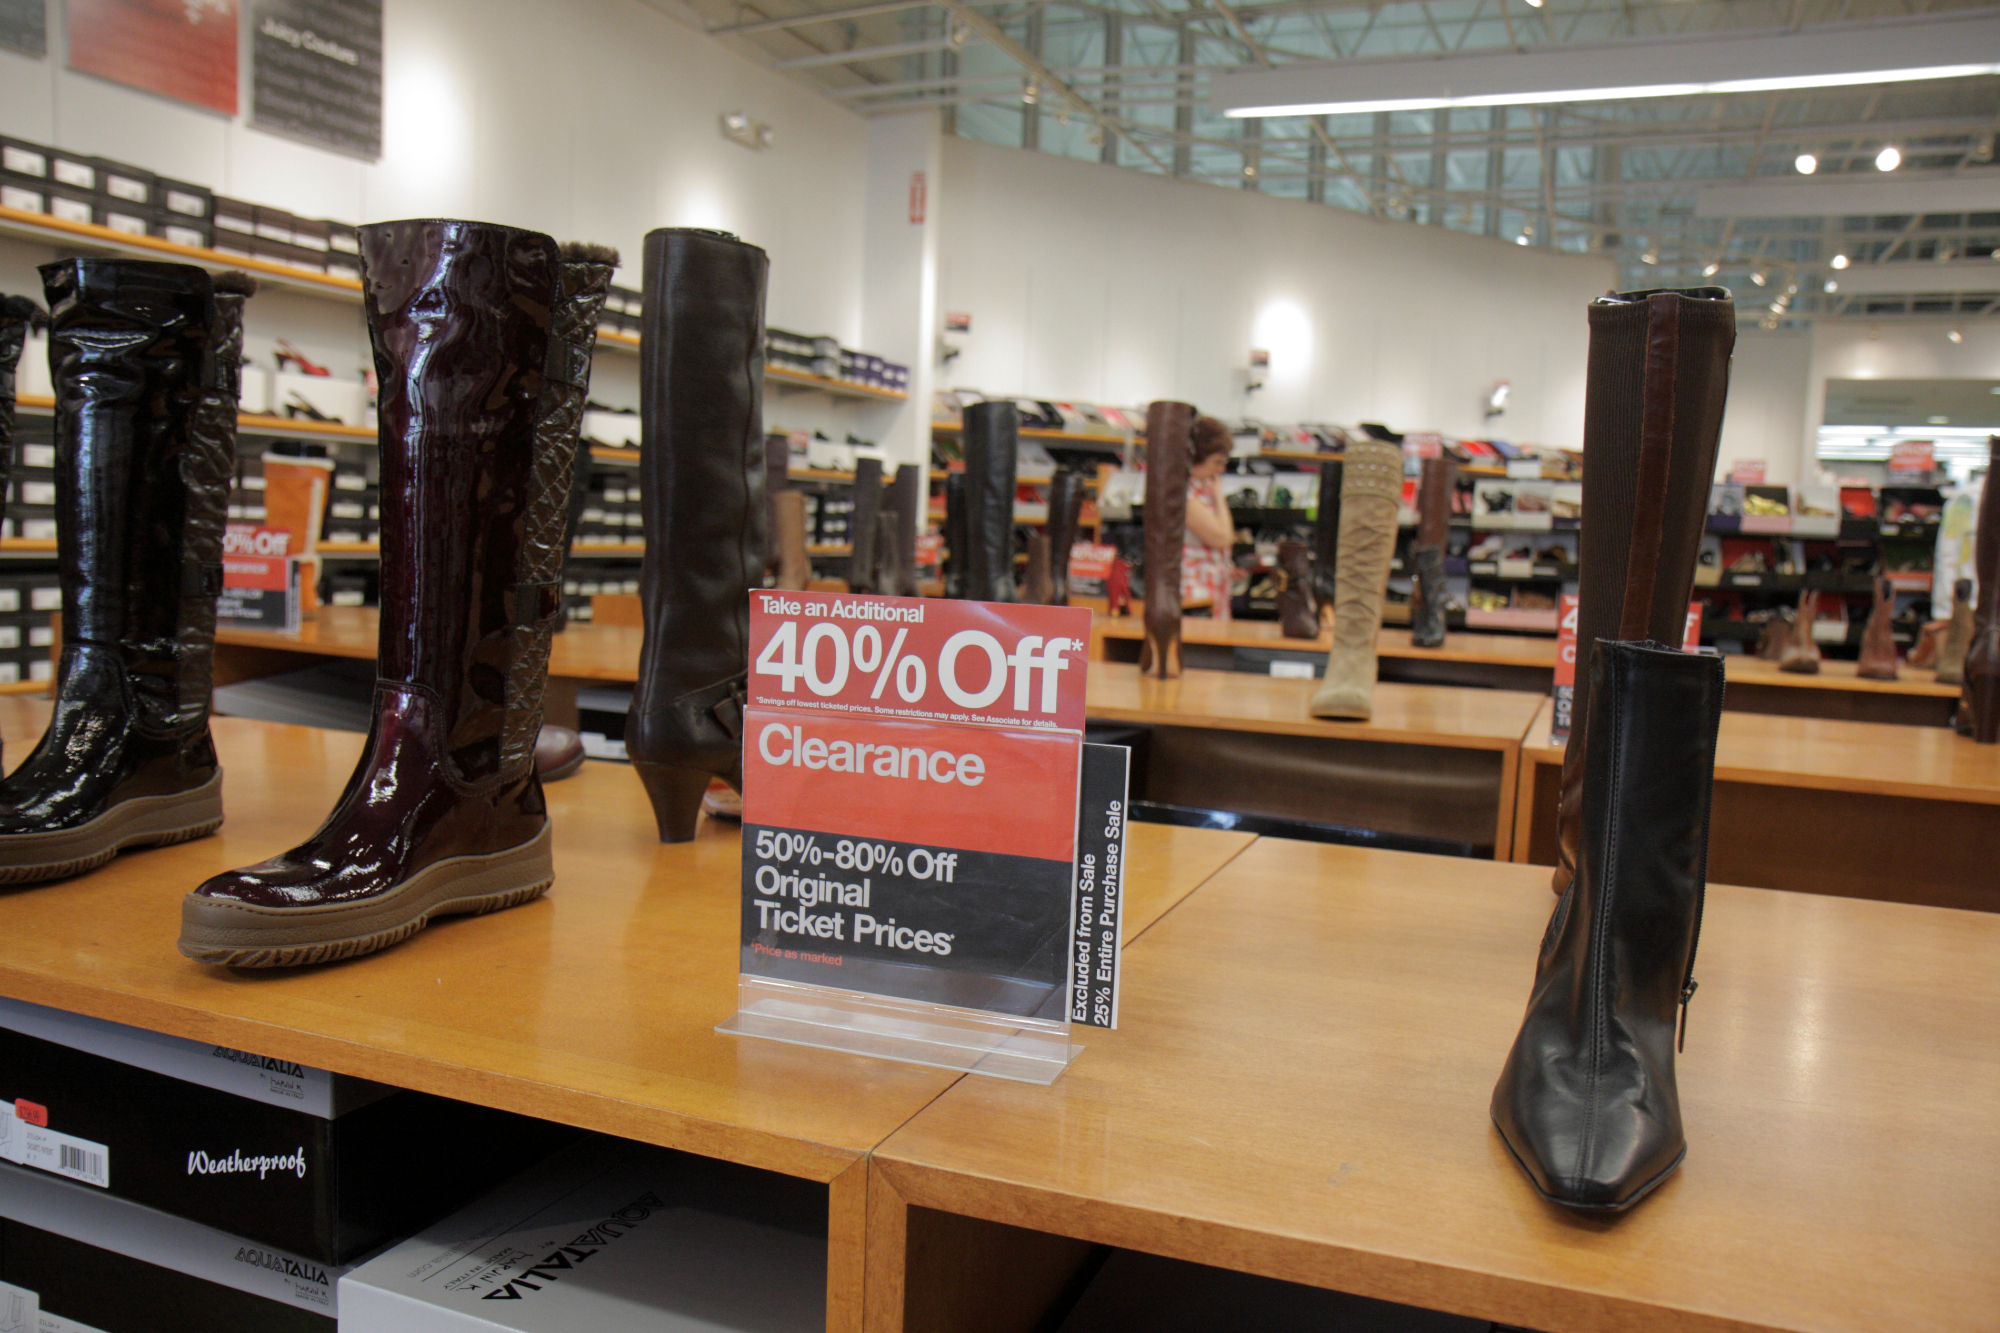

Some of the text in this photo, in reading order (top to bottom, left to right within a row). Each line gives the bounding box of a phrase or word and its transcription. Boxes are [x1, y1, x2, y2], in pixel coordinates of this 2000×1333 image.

[759, 595, 925, 623] Take an Additional
[756, 621, 927, 703] 40%
[786, 699, 797, 707] off
[797, 700, 820, 709] lowest
[820, 702, 849, 711] ticketed
[849, 704, 873, 714] prices.
[874, 706, 894, 715] Some
[895, 708, 933, 718] restrictions
[950, 714, 970, 722] apply.
[971, 714, 985, 722] See
[986, 715, 1020, 725] Associate
[1021, 717, 1032, 726] for
[1033, 718, 1058, 728] details.
[758, 722, 986, 787] Clearance
[755, 829, 958, 883] 50%-80% Off
[755, 864, 871, 908] Original
[753, 899, 845, 941] Ticket
[1093, 800, 1122, 1027] 25% Entire Purchase Sale
[784, 949, 798, 960] as
[800, 952, 843, 966] marked
[1072, 853, 1096, 1022] Excluded from Sale
[187, 1146, 306, 1180] Weatherproof
[234, 1247, 329, 1286] AQUATALIA
[481, 1191, 666, 1300] AQUATALIA
[444, 1247, 513, 1289] MADE IN ITALY
